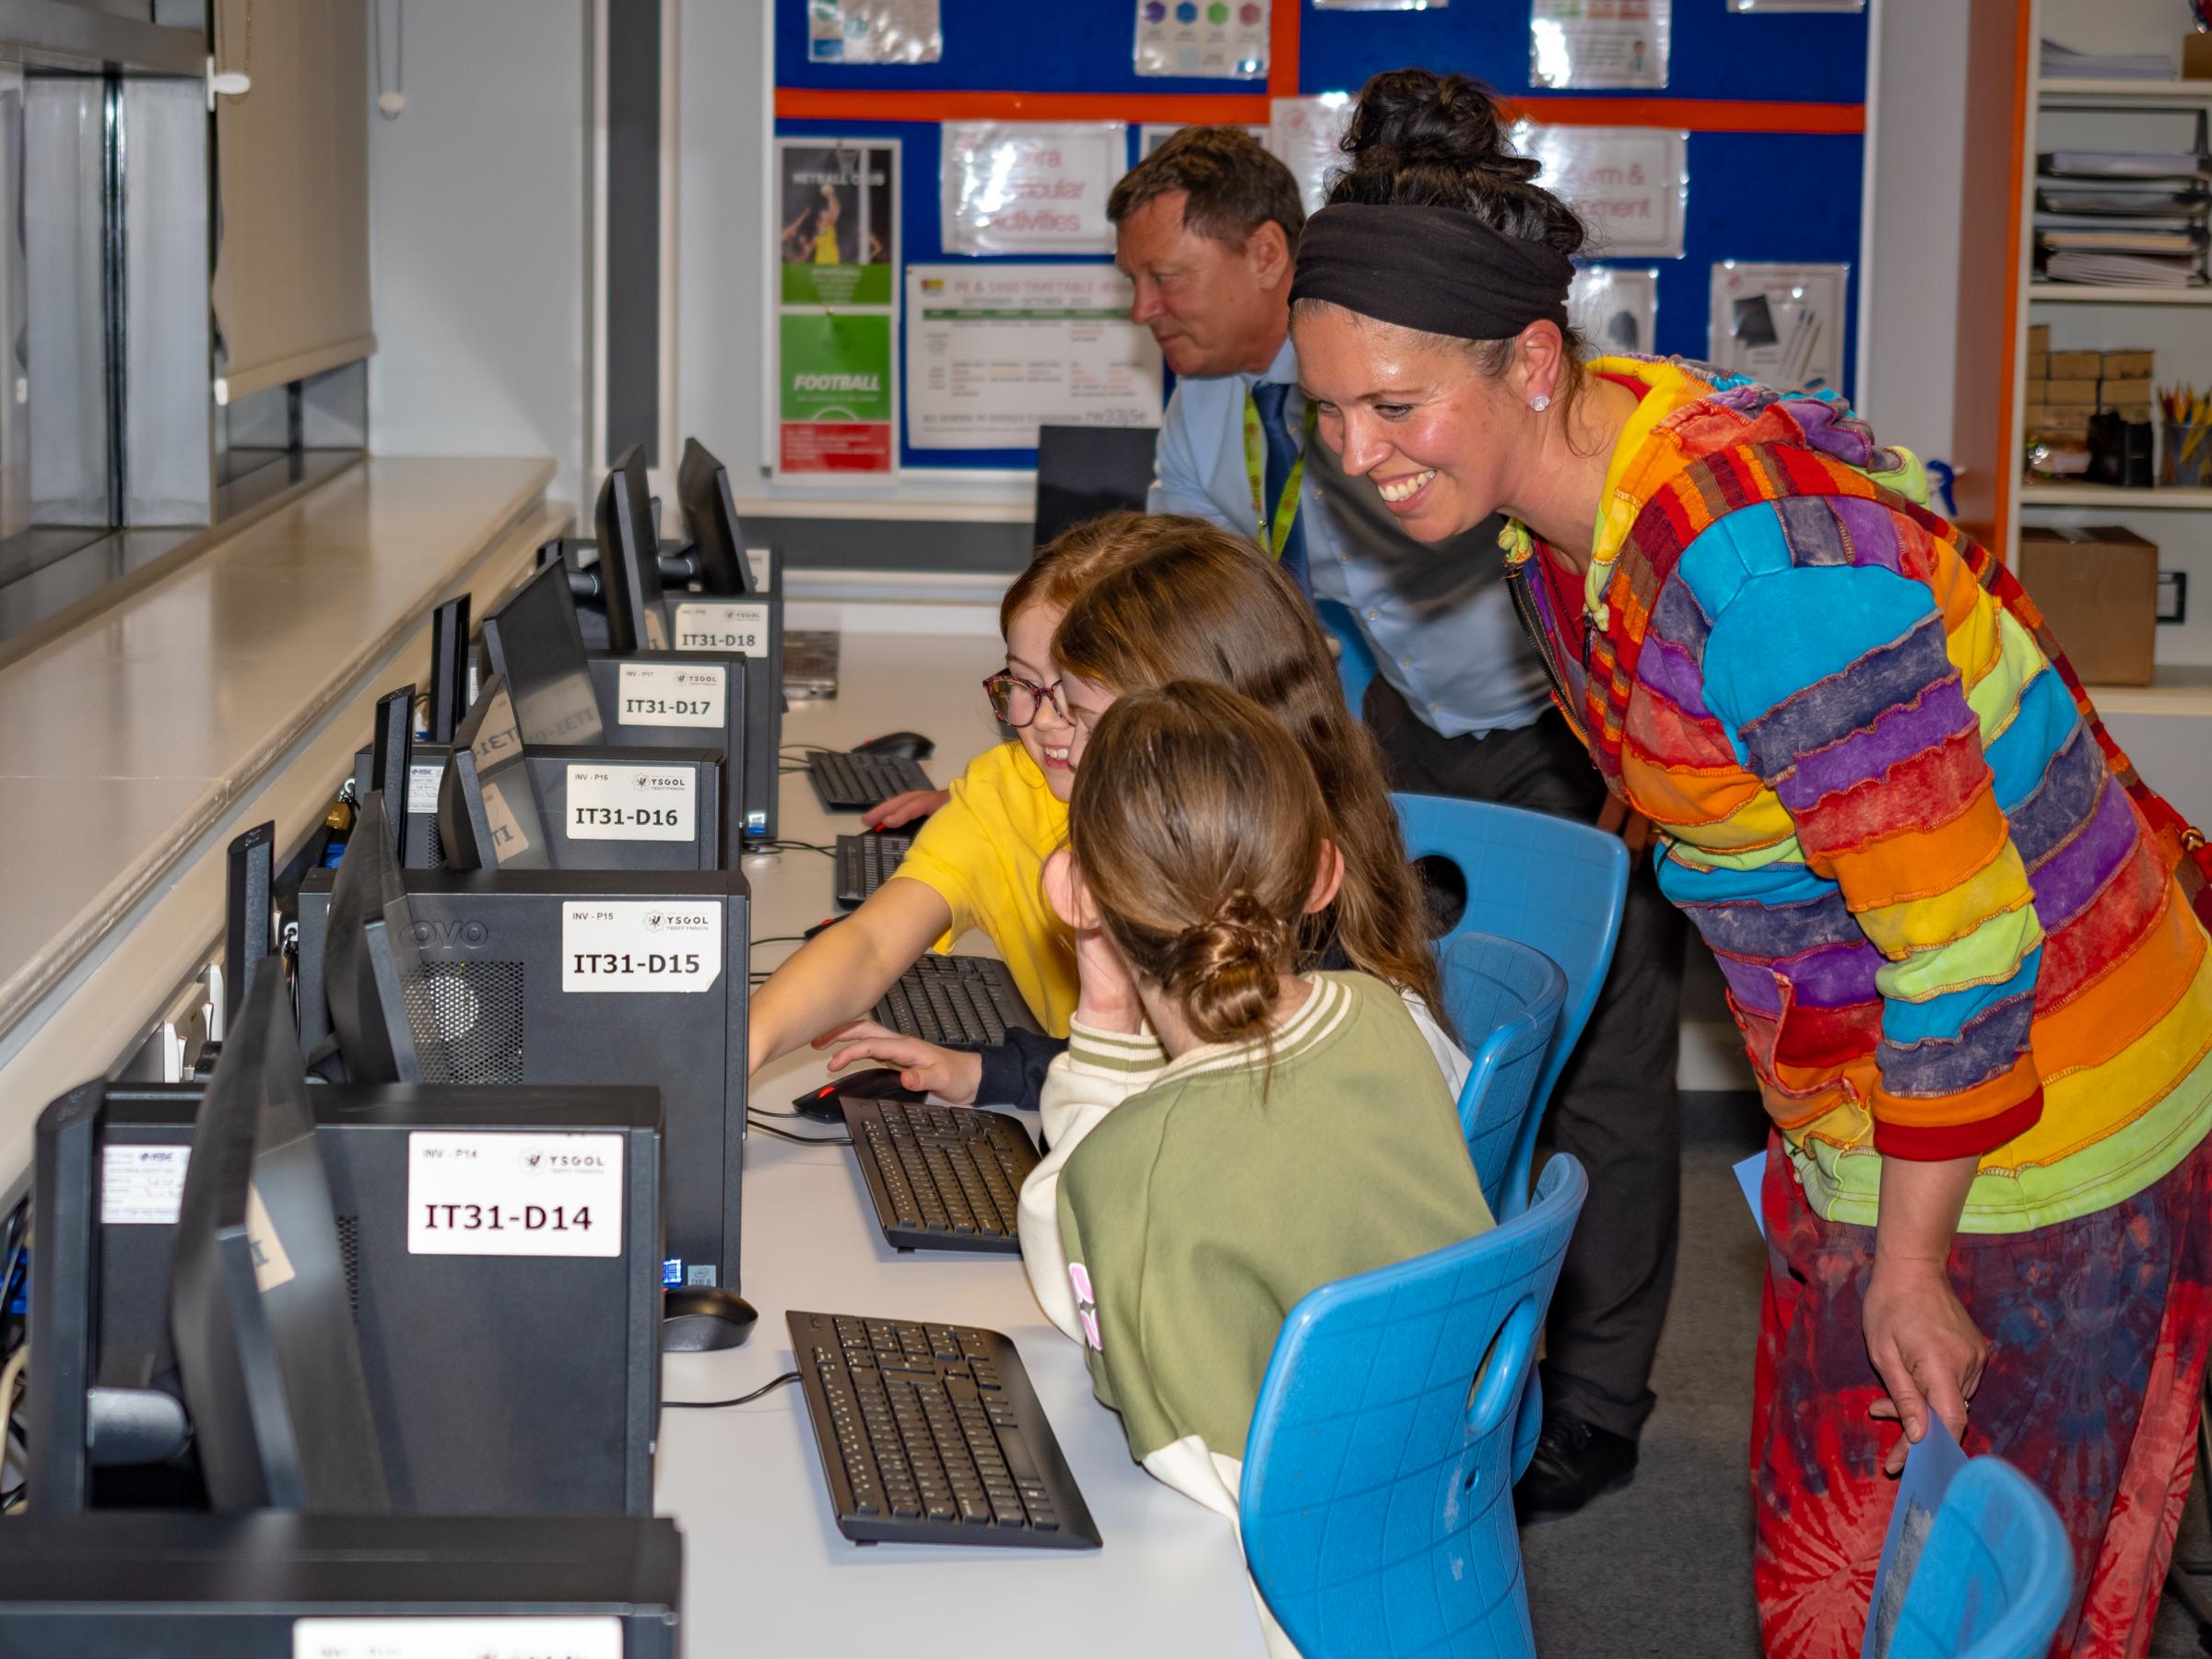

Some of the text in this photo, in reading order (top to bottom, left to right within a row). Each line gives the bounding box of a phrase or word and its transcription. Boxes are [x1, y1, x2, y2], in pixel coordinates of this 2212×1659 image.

[794, 374, 880, 392] FOOTBALL
[682, 634, 756, 647] IT31-D18
[627, 700, 711, 715] IT31-D17
[576, 808, 678, 827] IT31-D16
[572, 912, 588, 921] INV
[597, 912, 614, 921] P15
[666, 916, 709, 925] YSGOL
[574, 954, 700, 974] IT31-D15
[549, 1156, 605, 1167] YSGOL
[425, 1205, 593, 1230] IT31-D14
